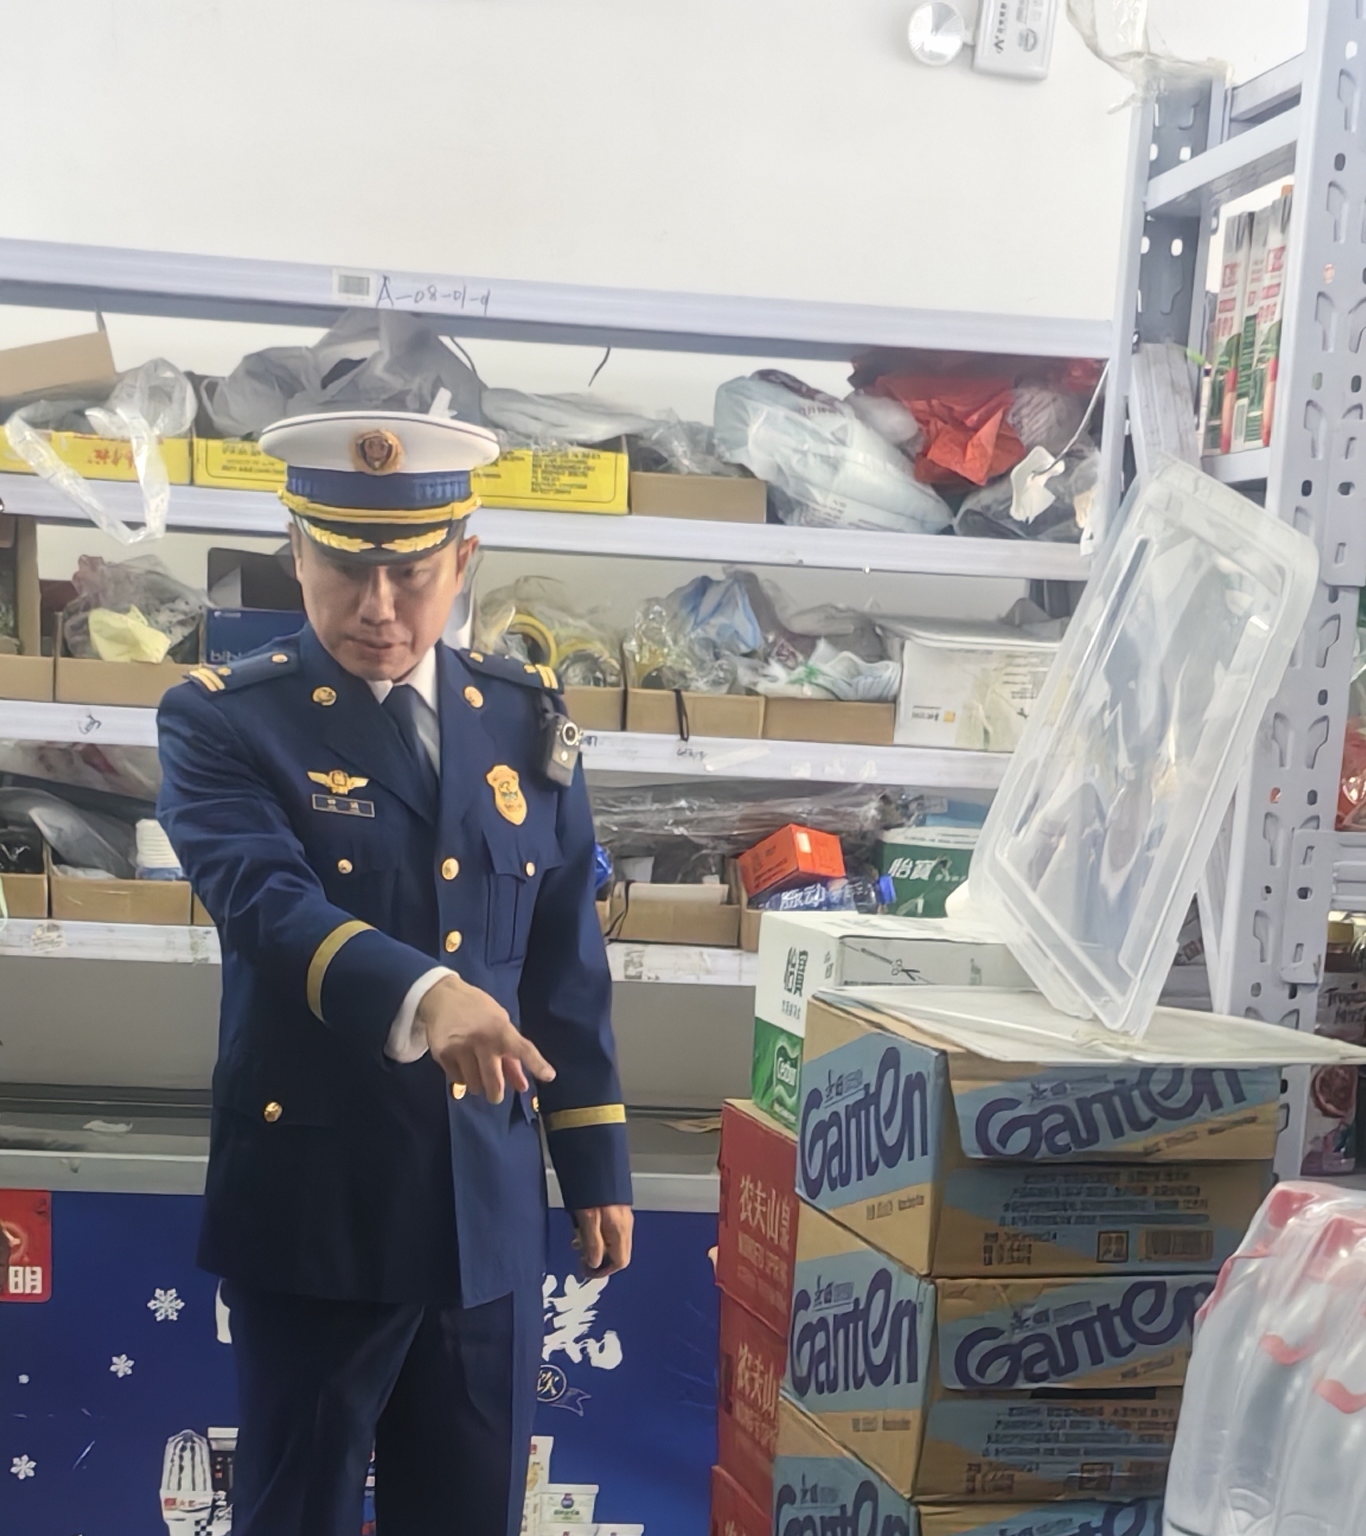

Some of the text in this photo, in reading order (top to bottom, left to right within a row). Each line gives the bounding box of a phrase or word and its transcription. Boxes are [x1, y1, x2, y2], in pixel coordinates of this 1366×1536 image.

[799, 1046, 928, 1199] Ganten
[975, 1066, 1247, 1160] Ganten
[790, 1268, 920, 1398] Ganten
